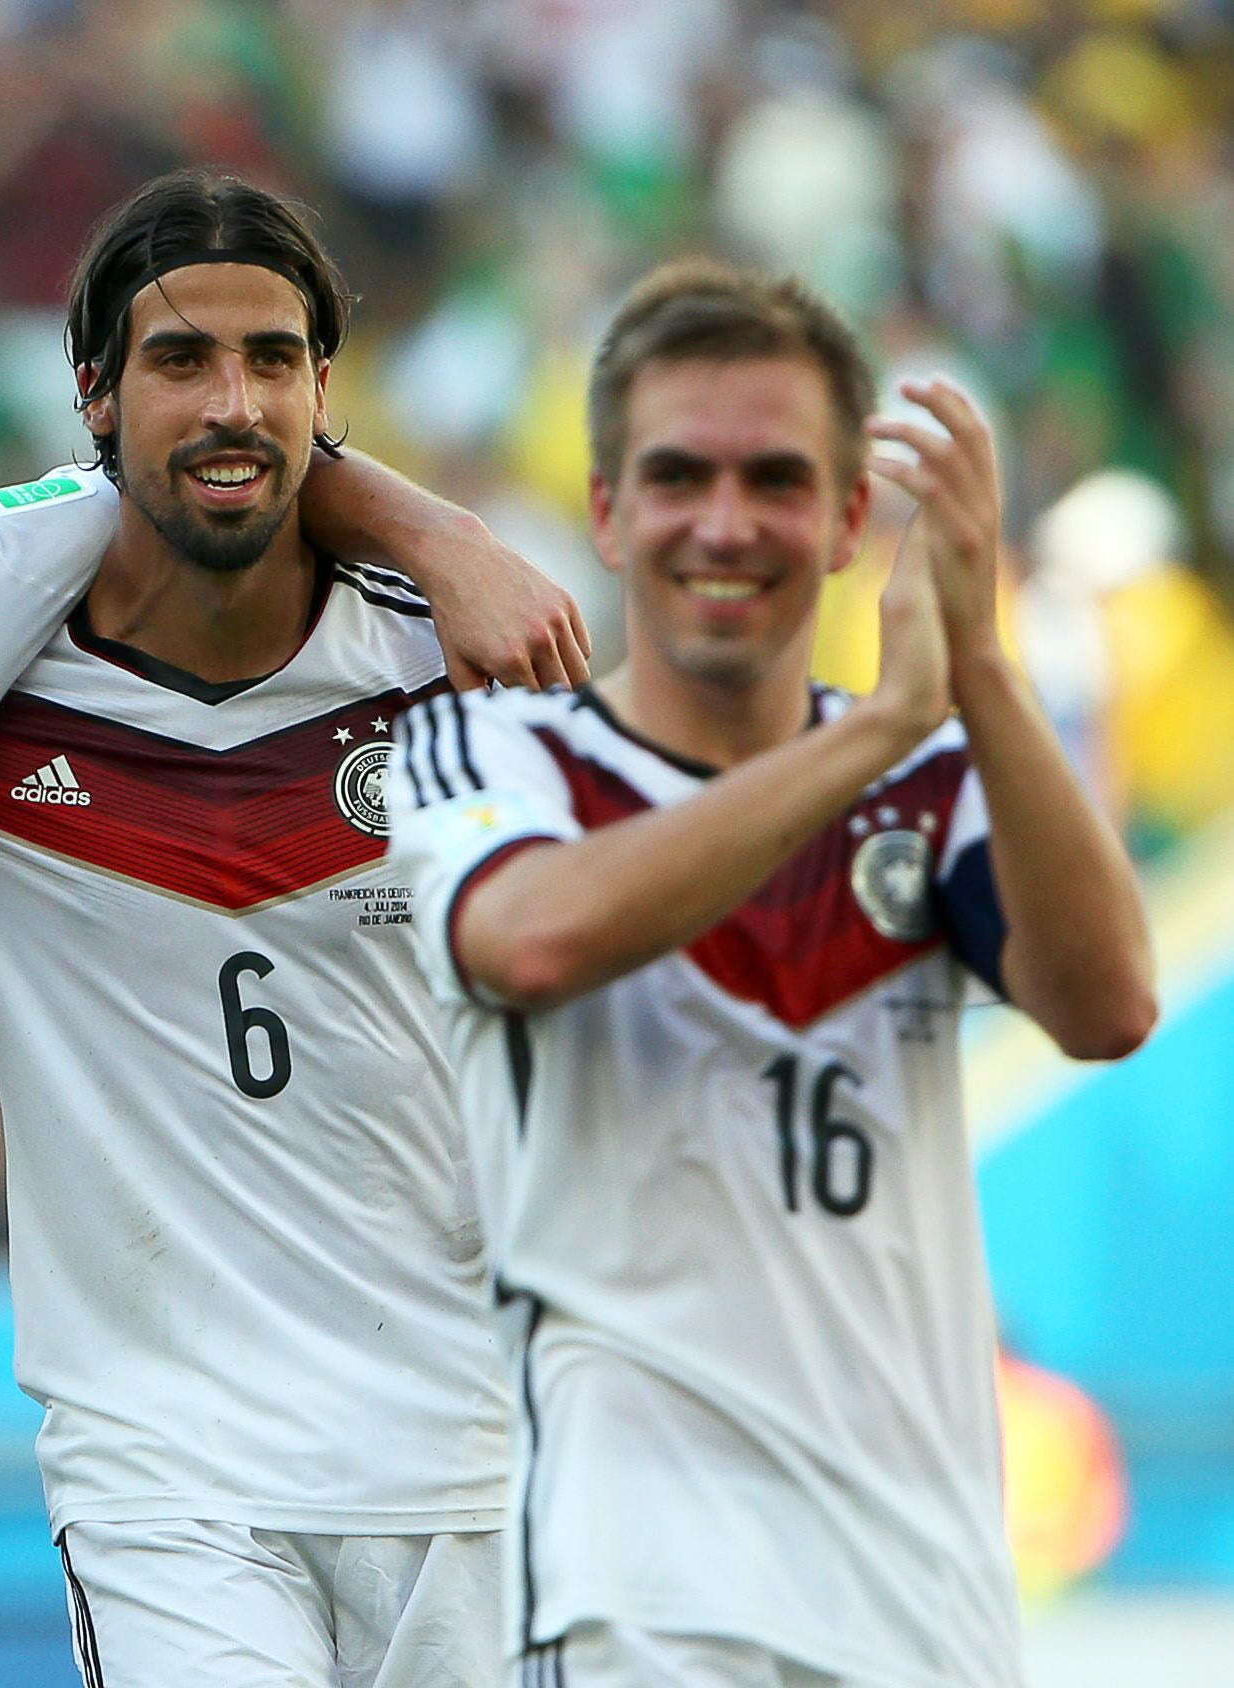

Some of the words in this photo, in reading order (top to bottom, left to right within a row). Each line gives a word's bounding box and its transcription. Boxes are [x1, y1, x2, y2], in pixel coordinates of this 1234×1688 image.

[10, 785, 91, 806] adidas
[377, 887, 387, 898] VS
[219, 951, 292, 1099] 6
[760, 1053, 873, 1217] 16
